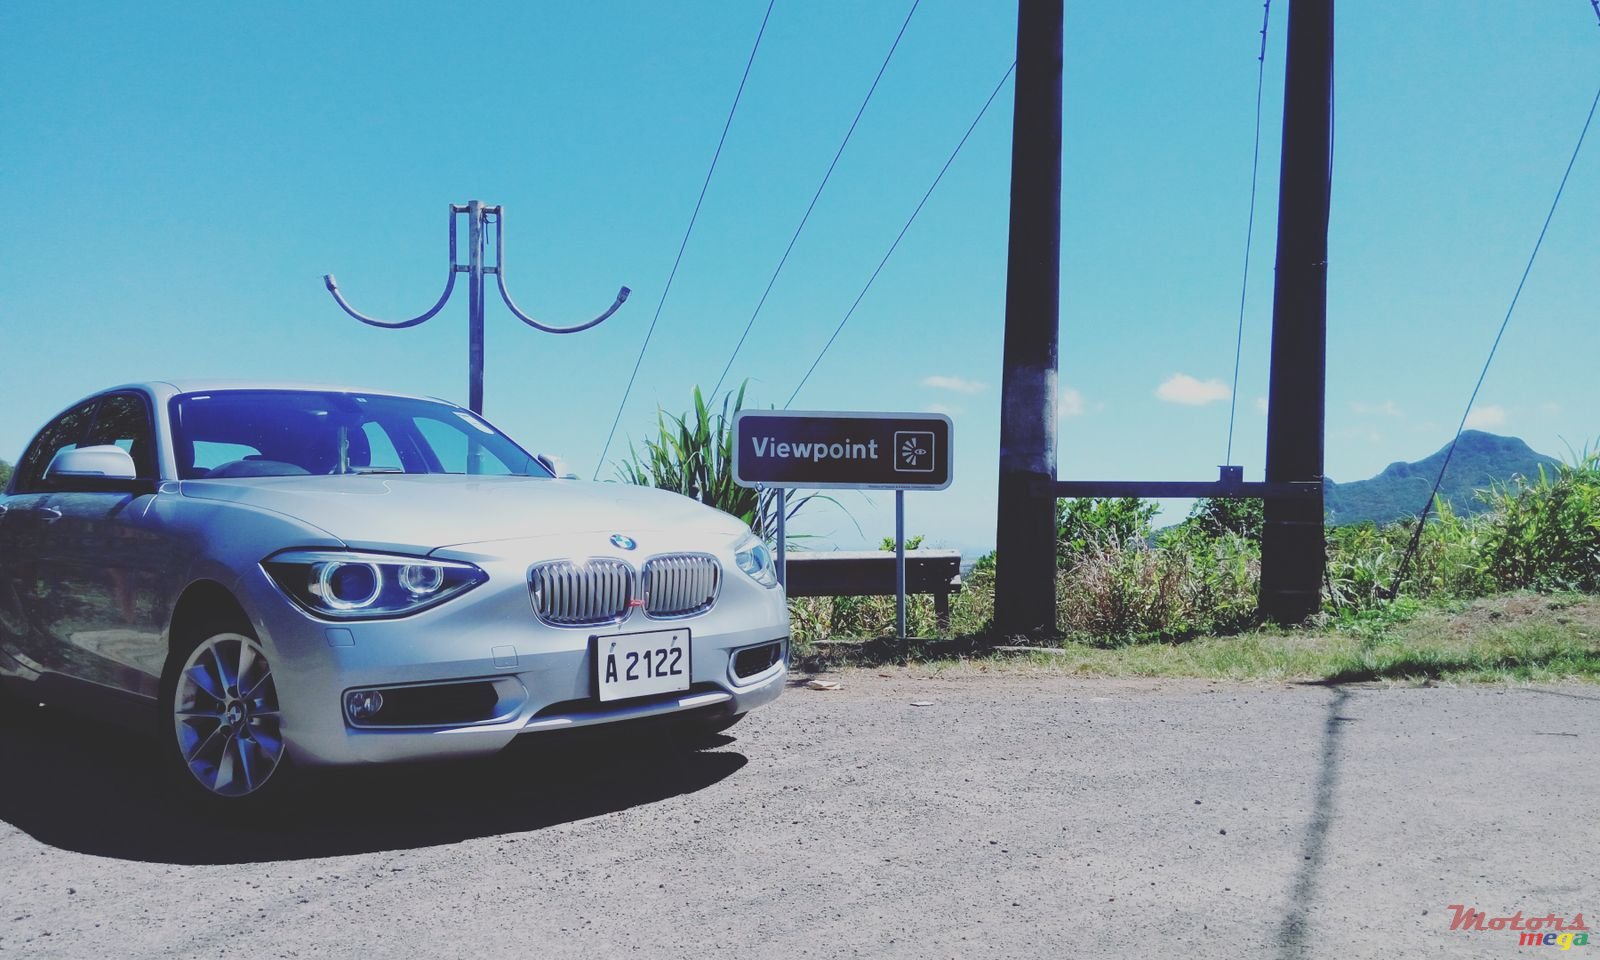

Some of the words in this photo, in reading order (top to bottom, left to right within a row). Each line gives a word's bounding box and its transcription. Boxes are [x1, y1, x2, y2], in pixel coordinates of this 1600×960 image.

[752, 436, 878, 462] Viewpoint
[605, 653, 618, 684] A
[626, 647, 682, 681] 2122
